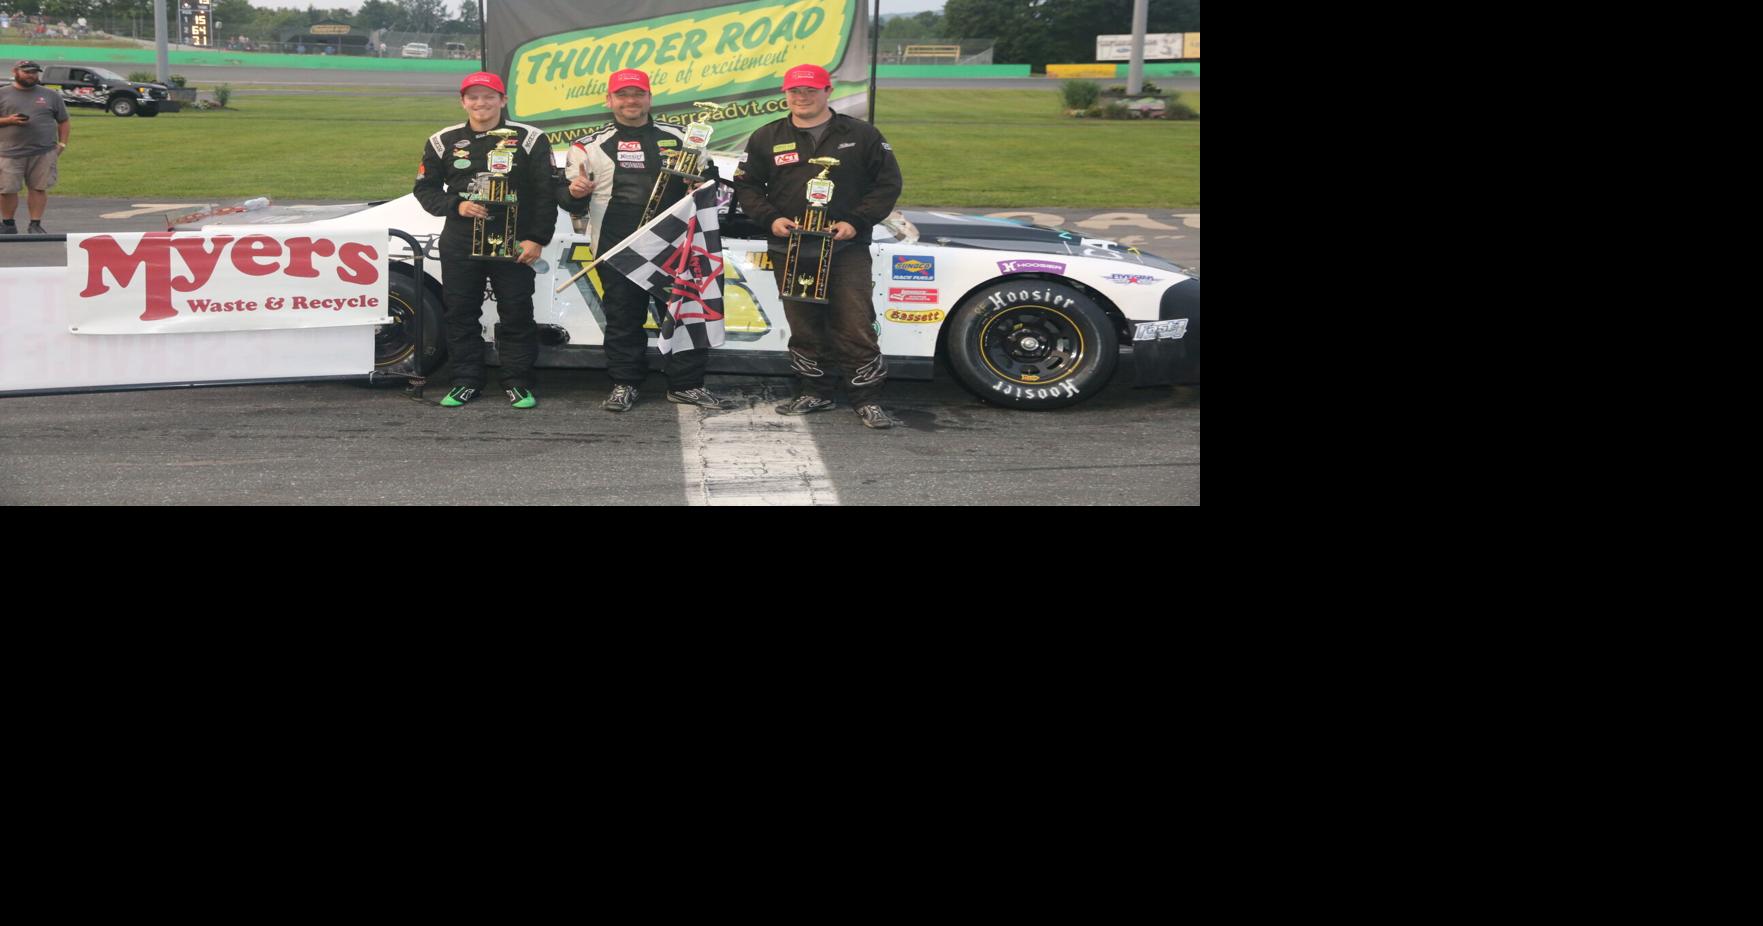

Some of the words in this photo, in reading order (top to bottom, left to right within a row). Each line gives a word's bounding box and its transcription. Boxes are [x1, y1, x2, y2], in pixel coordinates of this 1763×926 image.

[191, 25, 207, 35] 64
[194, 15, 206, 25] 15
[527, 27, 707, 85] THUNDER
[715, 6, 825, 55] ROAD
[675, 60, 693, 84] of
[776, 153, 797, 164] ACT
[79, 231, 379, 321] Myers
[187, 299, 257, 313] Waste
[265, 296, 283, 310] &
[292, 294, 379, 311] Recycle
[988, 288, 1075, 311] Hoosier
[992, 379, 1080, 401] Hoosier
